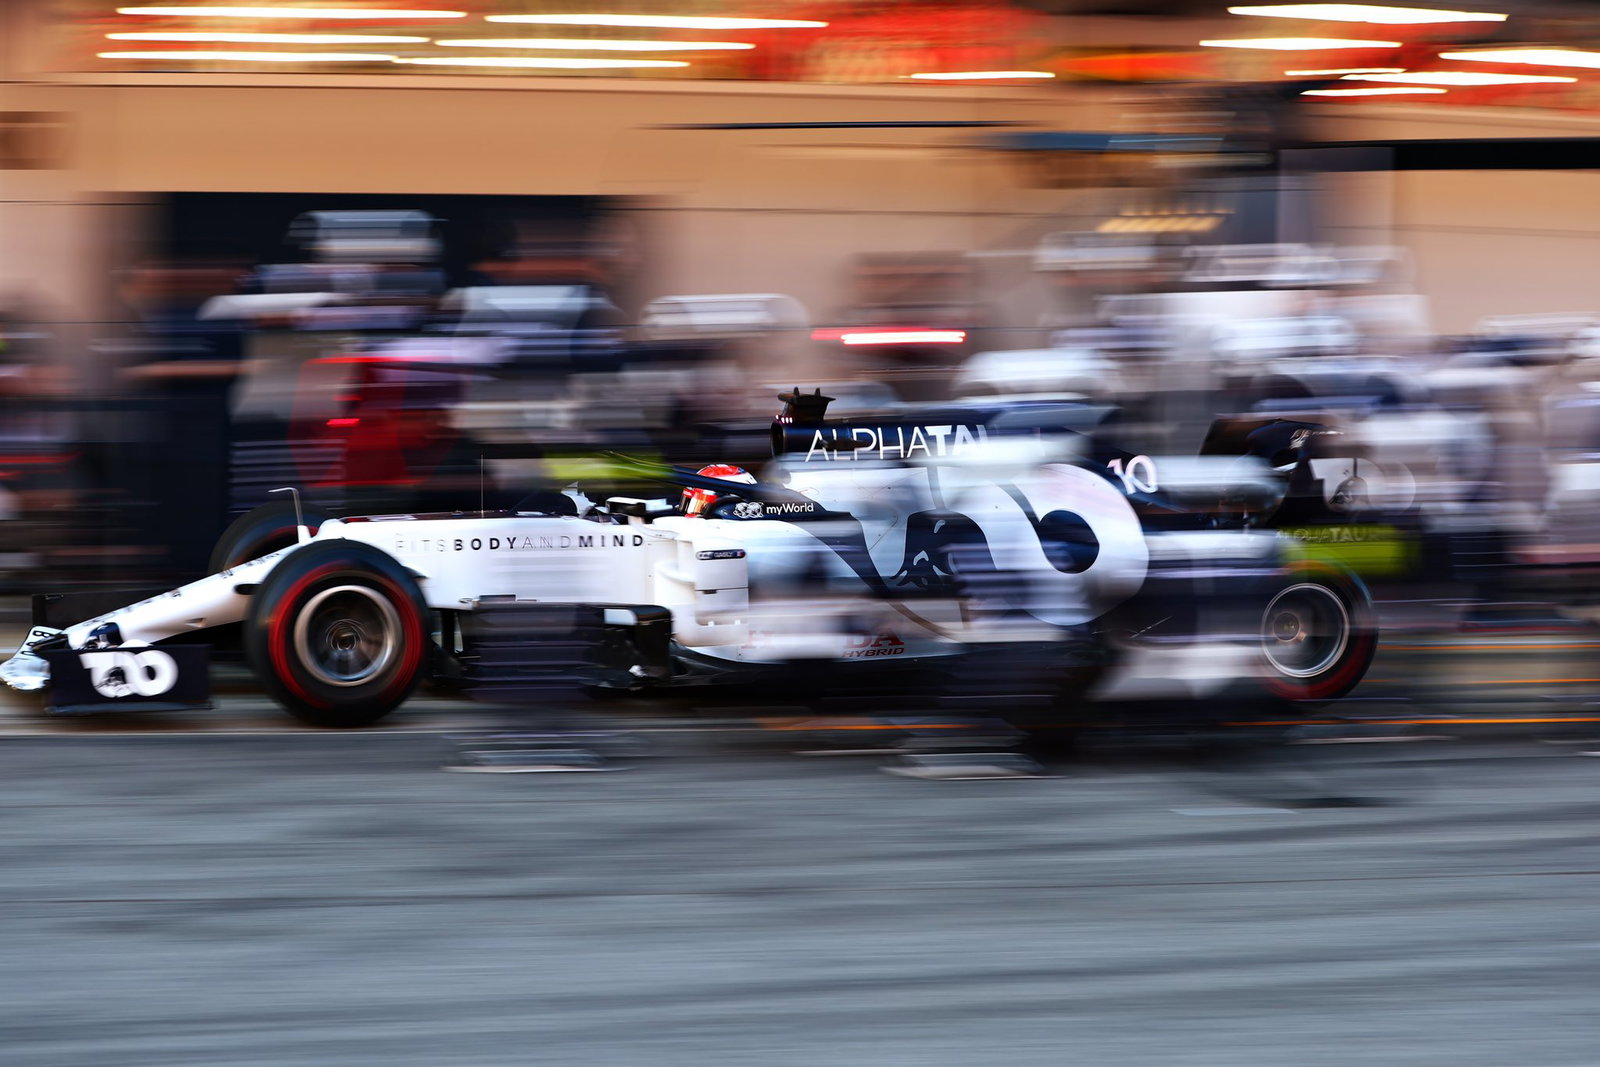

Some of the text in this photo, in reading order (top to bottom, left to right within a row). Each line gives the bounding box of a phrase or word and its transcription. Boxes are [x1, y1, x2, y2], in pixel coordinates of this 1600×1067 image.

[805, 424, 996, 463] ALPHATA
[1106, 454, 1158, 495] 10
[766, 502, 815, 516] myWorld
[841, 646, 905, 659] HYBRID
